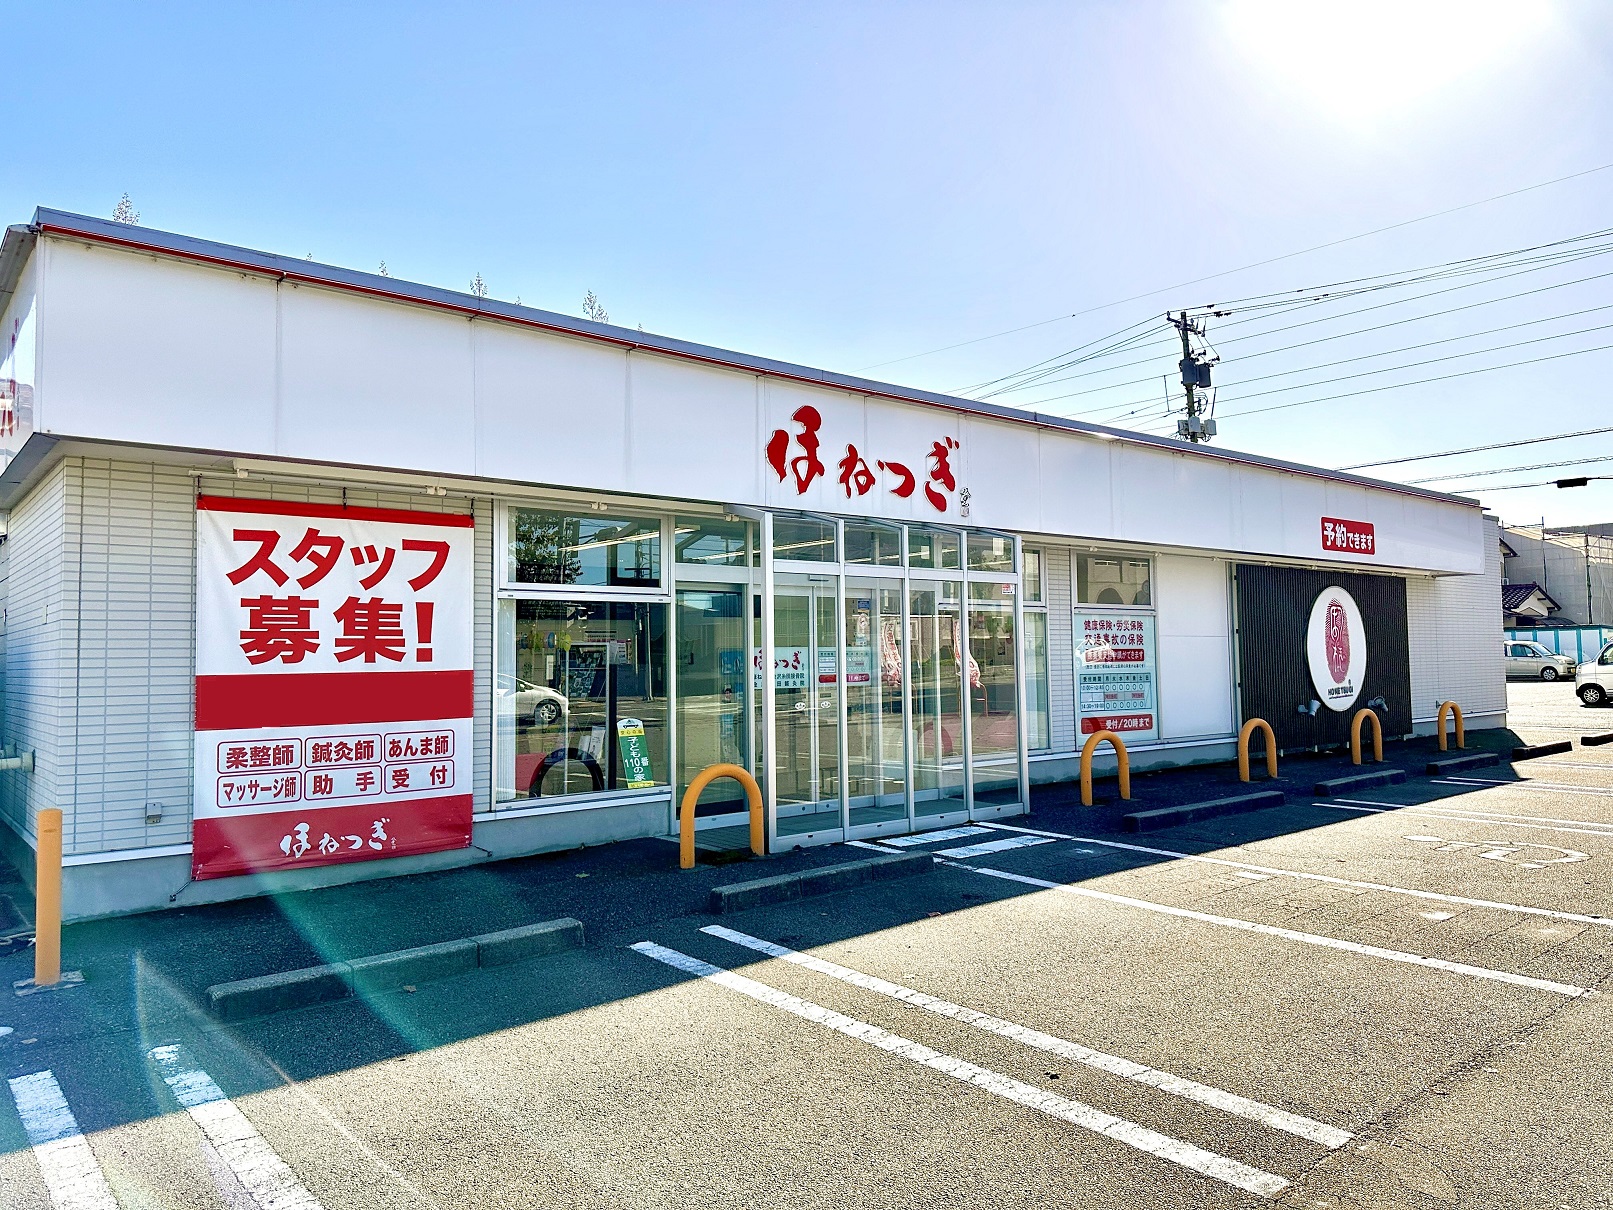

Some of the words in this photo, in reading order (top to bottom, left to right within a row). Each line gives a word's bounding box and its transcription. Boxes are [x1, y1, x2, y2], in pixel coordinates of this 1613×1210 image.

[766, 405, 960, 512] ほねつぎ
[1324, 522, 1373, 550] 予約できます
[227, 528, 451, 592] スタッフ
[240, 595, 435, 665] 募集!
[1084, 620, 1144, 631] 健康保険・労災保険
[1084, 633, 1144, 645] 交通事故の保険
[226, 744, 294, 769] 柔整師
[311, 740, 374, 763] 鍼灸師
[389, 736, 449, 758] あんま師
[223, 776, 296, 802] マッサージ師
[280, 818, 390, 858] ほねつぎ
